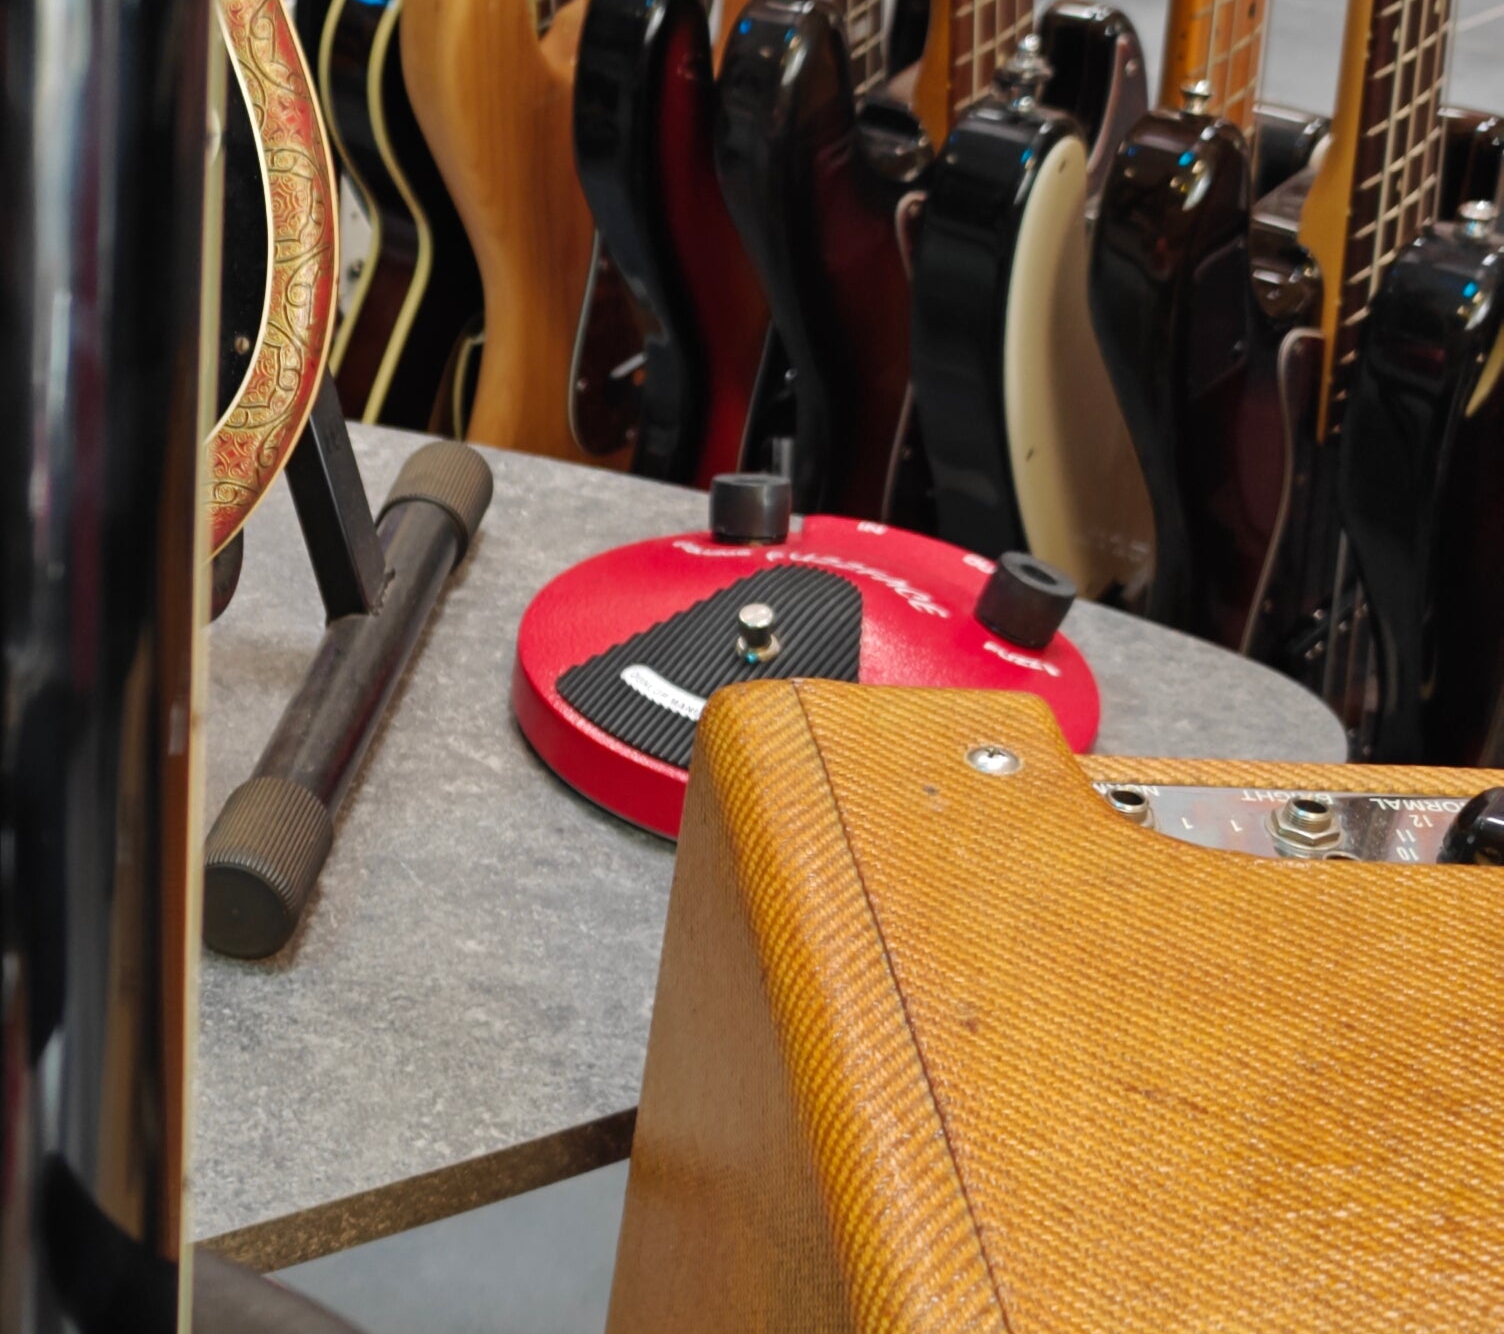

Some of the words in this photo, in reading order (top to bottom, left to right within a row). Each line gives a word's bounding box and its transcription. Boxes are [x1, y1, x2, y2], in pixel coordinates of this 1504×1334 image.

[1241, 790, 1334, 805] BGHT
[1369, 797, 1464, 813] ORMAL
[1408, 814, 1434, 828] 12
[1396, 828, 1416, 842] 11
[1396, 846, 1420, 862] 10
